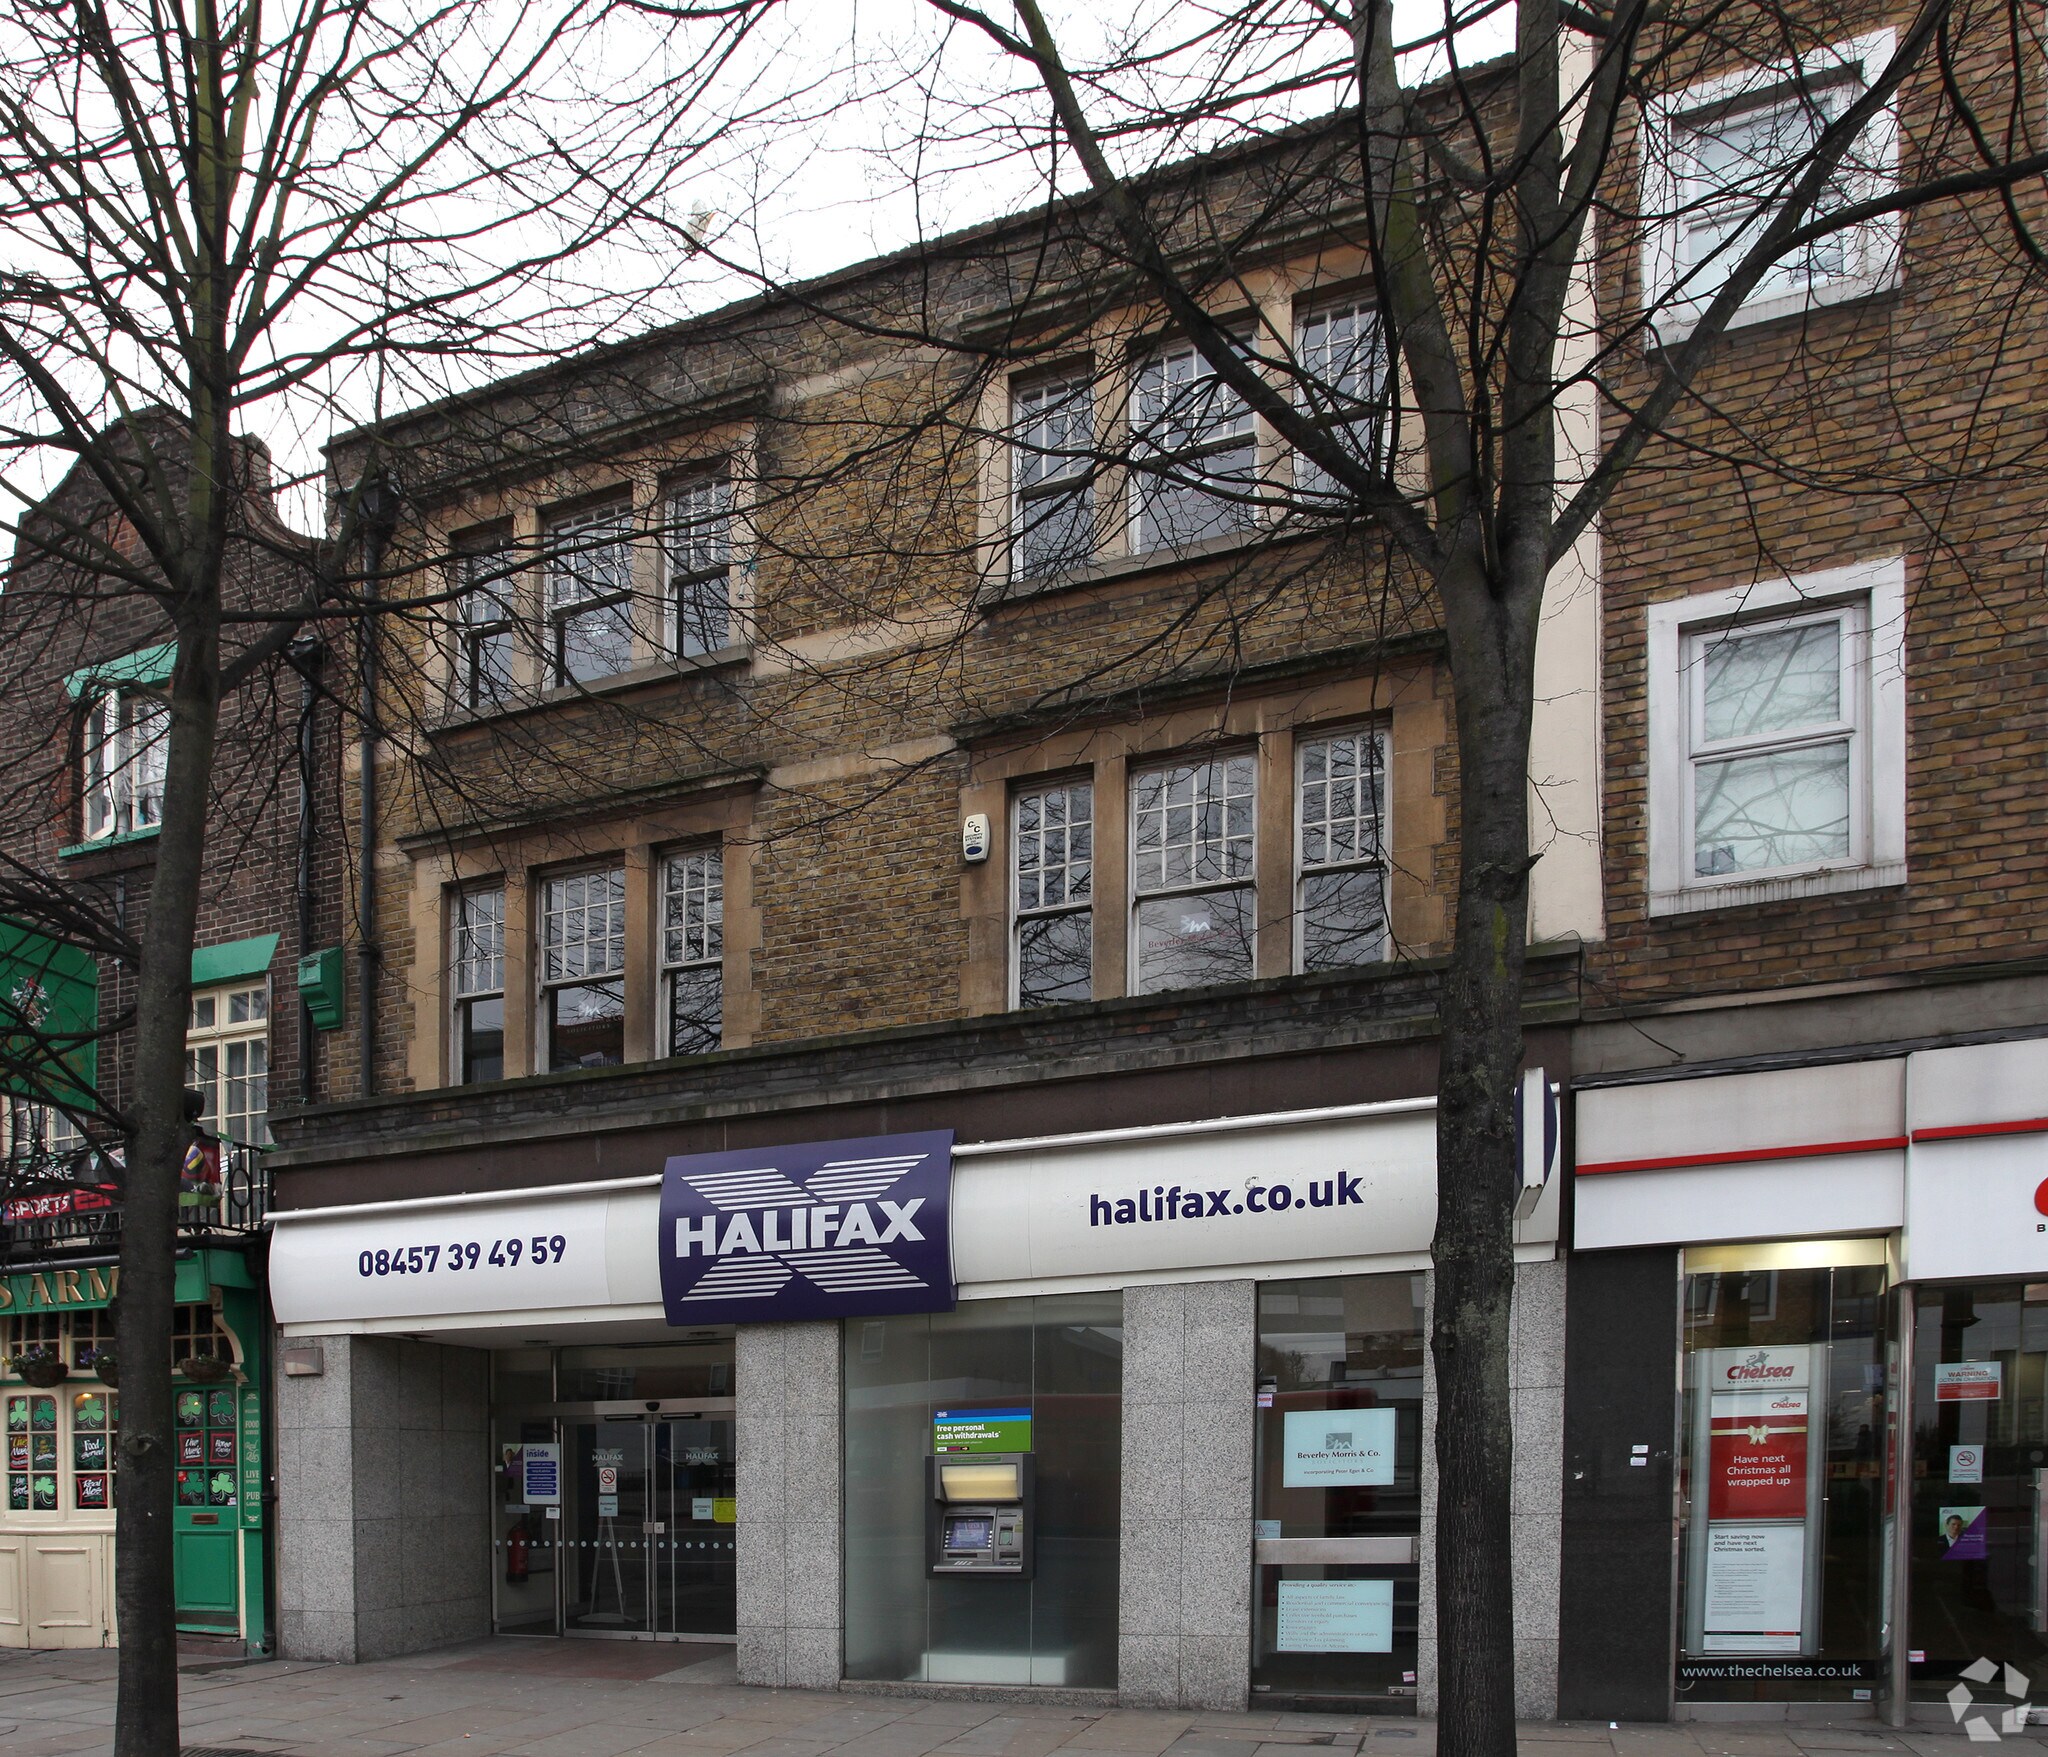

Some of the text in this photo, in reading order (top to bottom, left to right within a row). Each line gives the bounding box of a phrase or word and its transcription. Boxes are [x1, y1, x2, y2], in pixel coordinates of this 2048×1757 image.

[1090, 1170, 1364, 1226] halifax.co.uk
[9, 1195, 71, 1217] SPORTS
[676, 1198, 926, 1258] HALIFAX
[358, 1235, 566, 1277] 08457 39 49 59
[26, 1266, 120, 1306] ARM
[1727, 1364, 1794, 1380] Chelsea
[246, 1420, 259, 1428] FOOD
[953, 1424, 985, 1432] personal
[526, 1450, 548, 1458] inside
[686, 1452, 718, 1460] HALIFAX
[1298, 1452, 1329, 1460] Beverley
[1332, 1450, 1357, 1458] Morris
[1734, 1454, 1785, 1464] Have next
[246, 1470, 259, 1478] LIVE
[1726, 1464, 1791, 1476] Christmas all
[1727, 1477, 1790, 1487] wrapped up
[246, 1492, 260, 1500] PUB
[1682, 1664, 1861, 1677] www.thechelsea.co.uk
